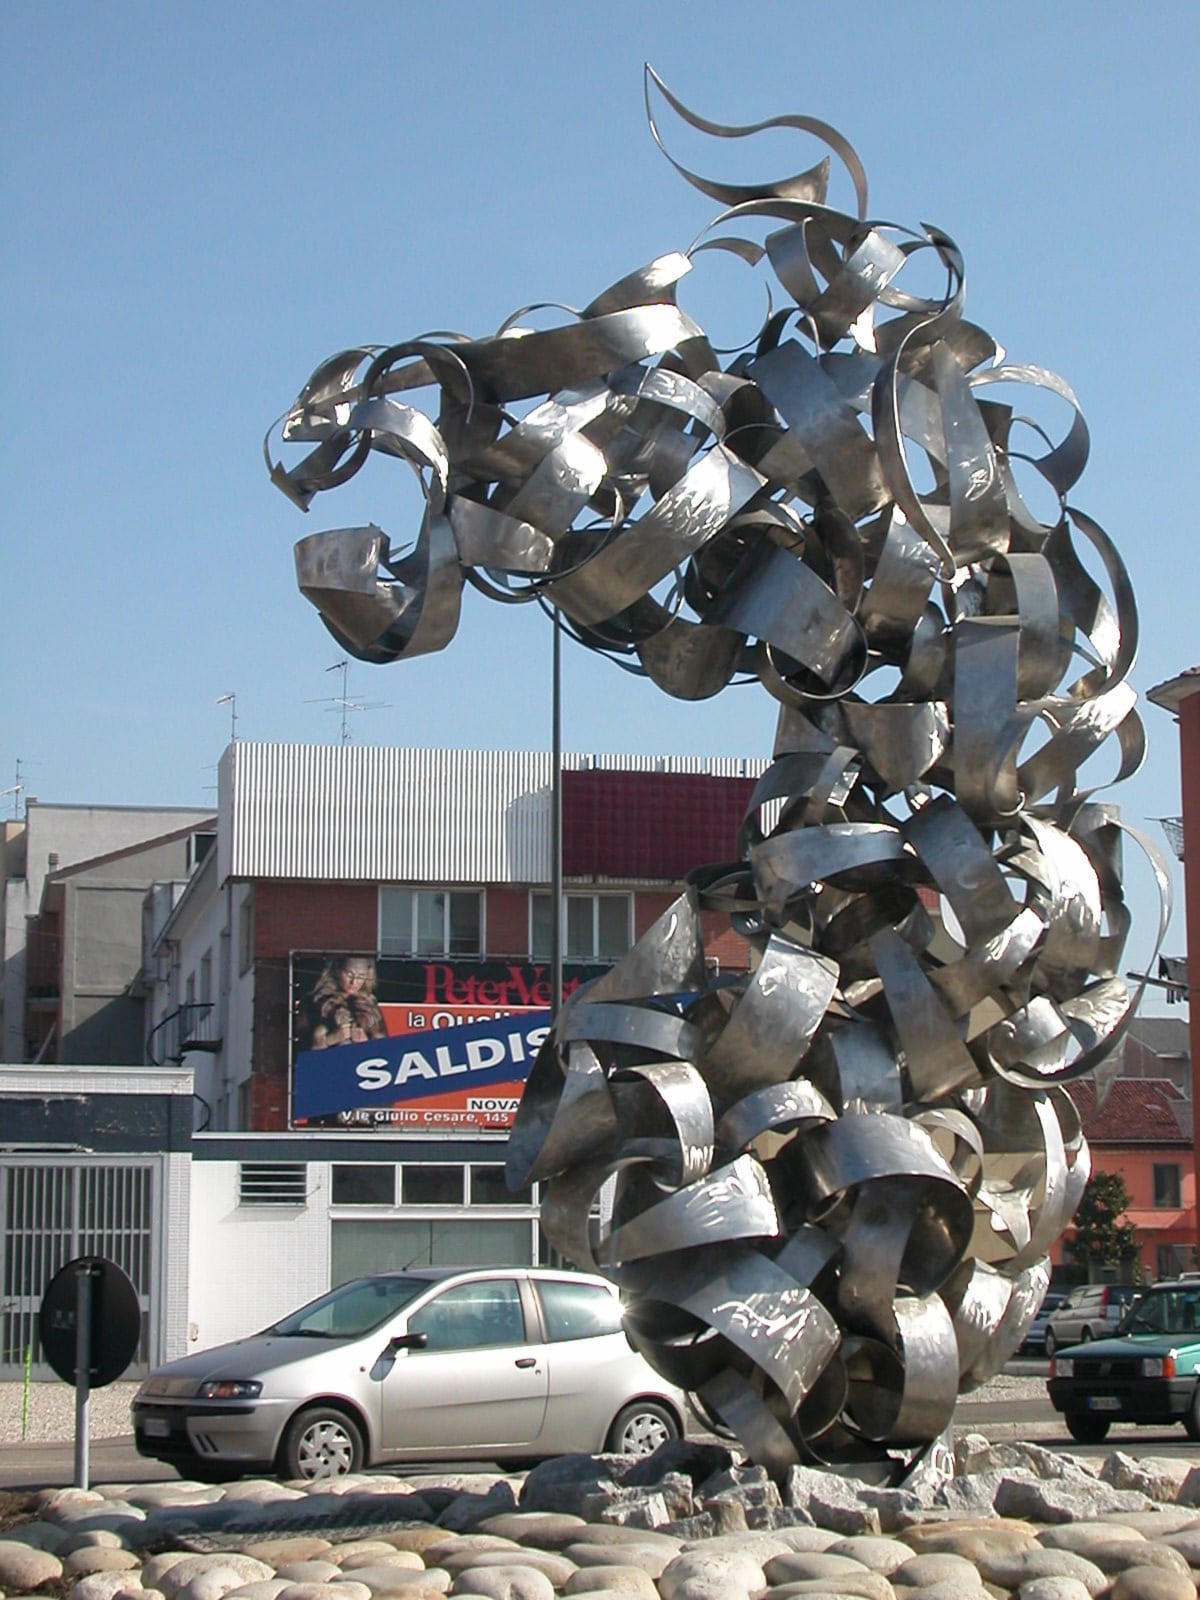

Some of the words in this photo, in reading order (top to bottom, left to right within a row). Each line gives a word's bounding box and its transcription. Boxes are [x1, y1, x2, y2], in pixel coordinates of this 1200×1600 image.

[408, 1011, 425, 1028] la
[374, 1111, 418, 1122] Giulio
[423, 1112, 479, 1123] Cesare,
[484, 1112, 509, 1122] 145
